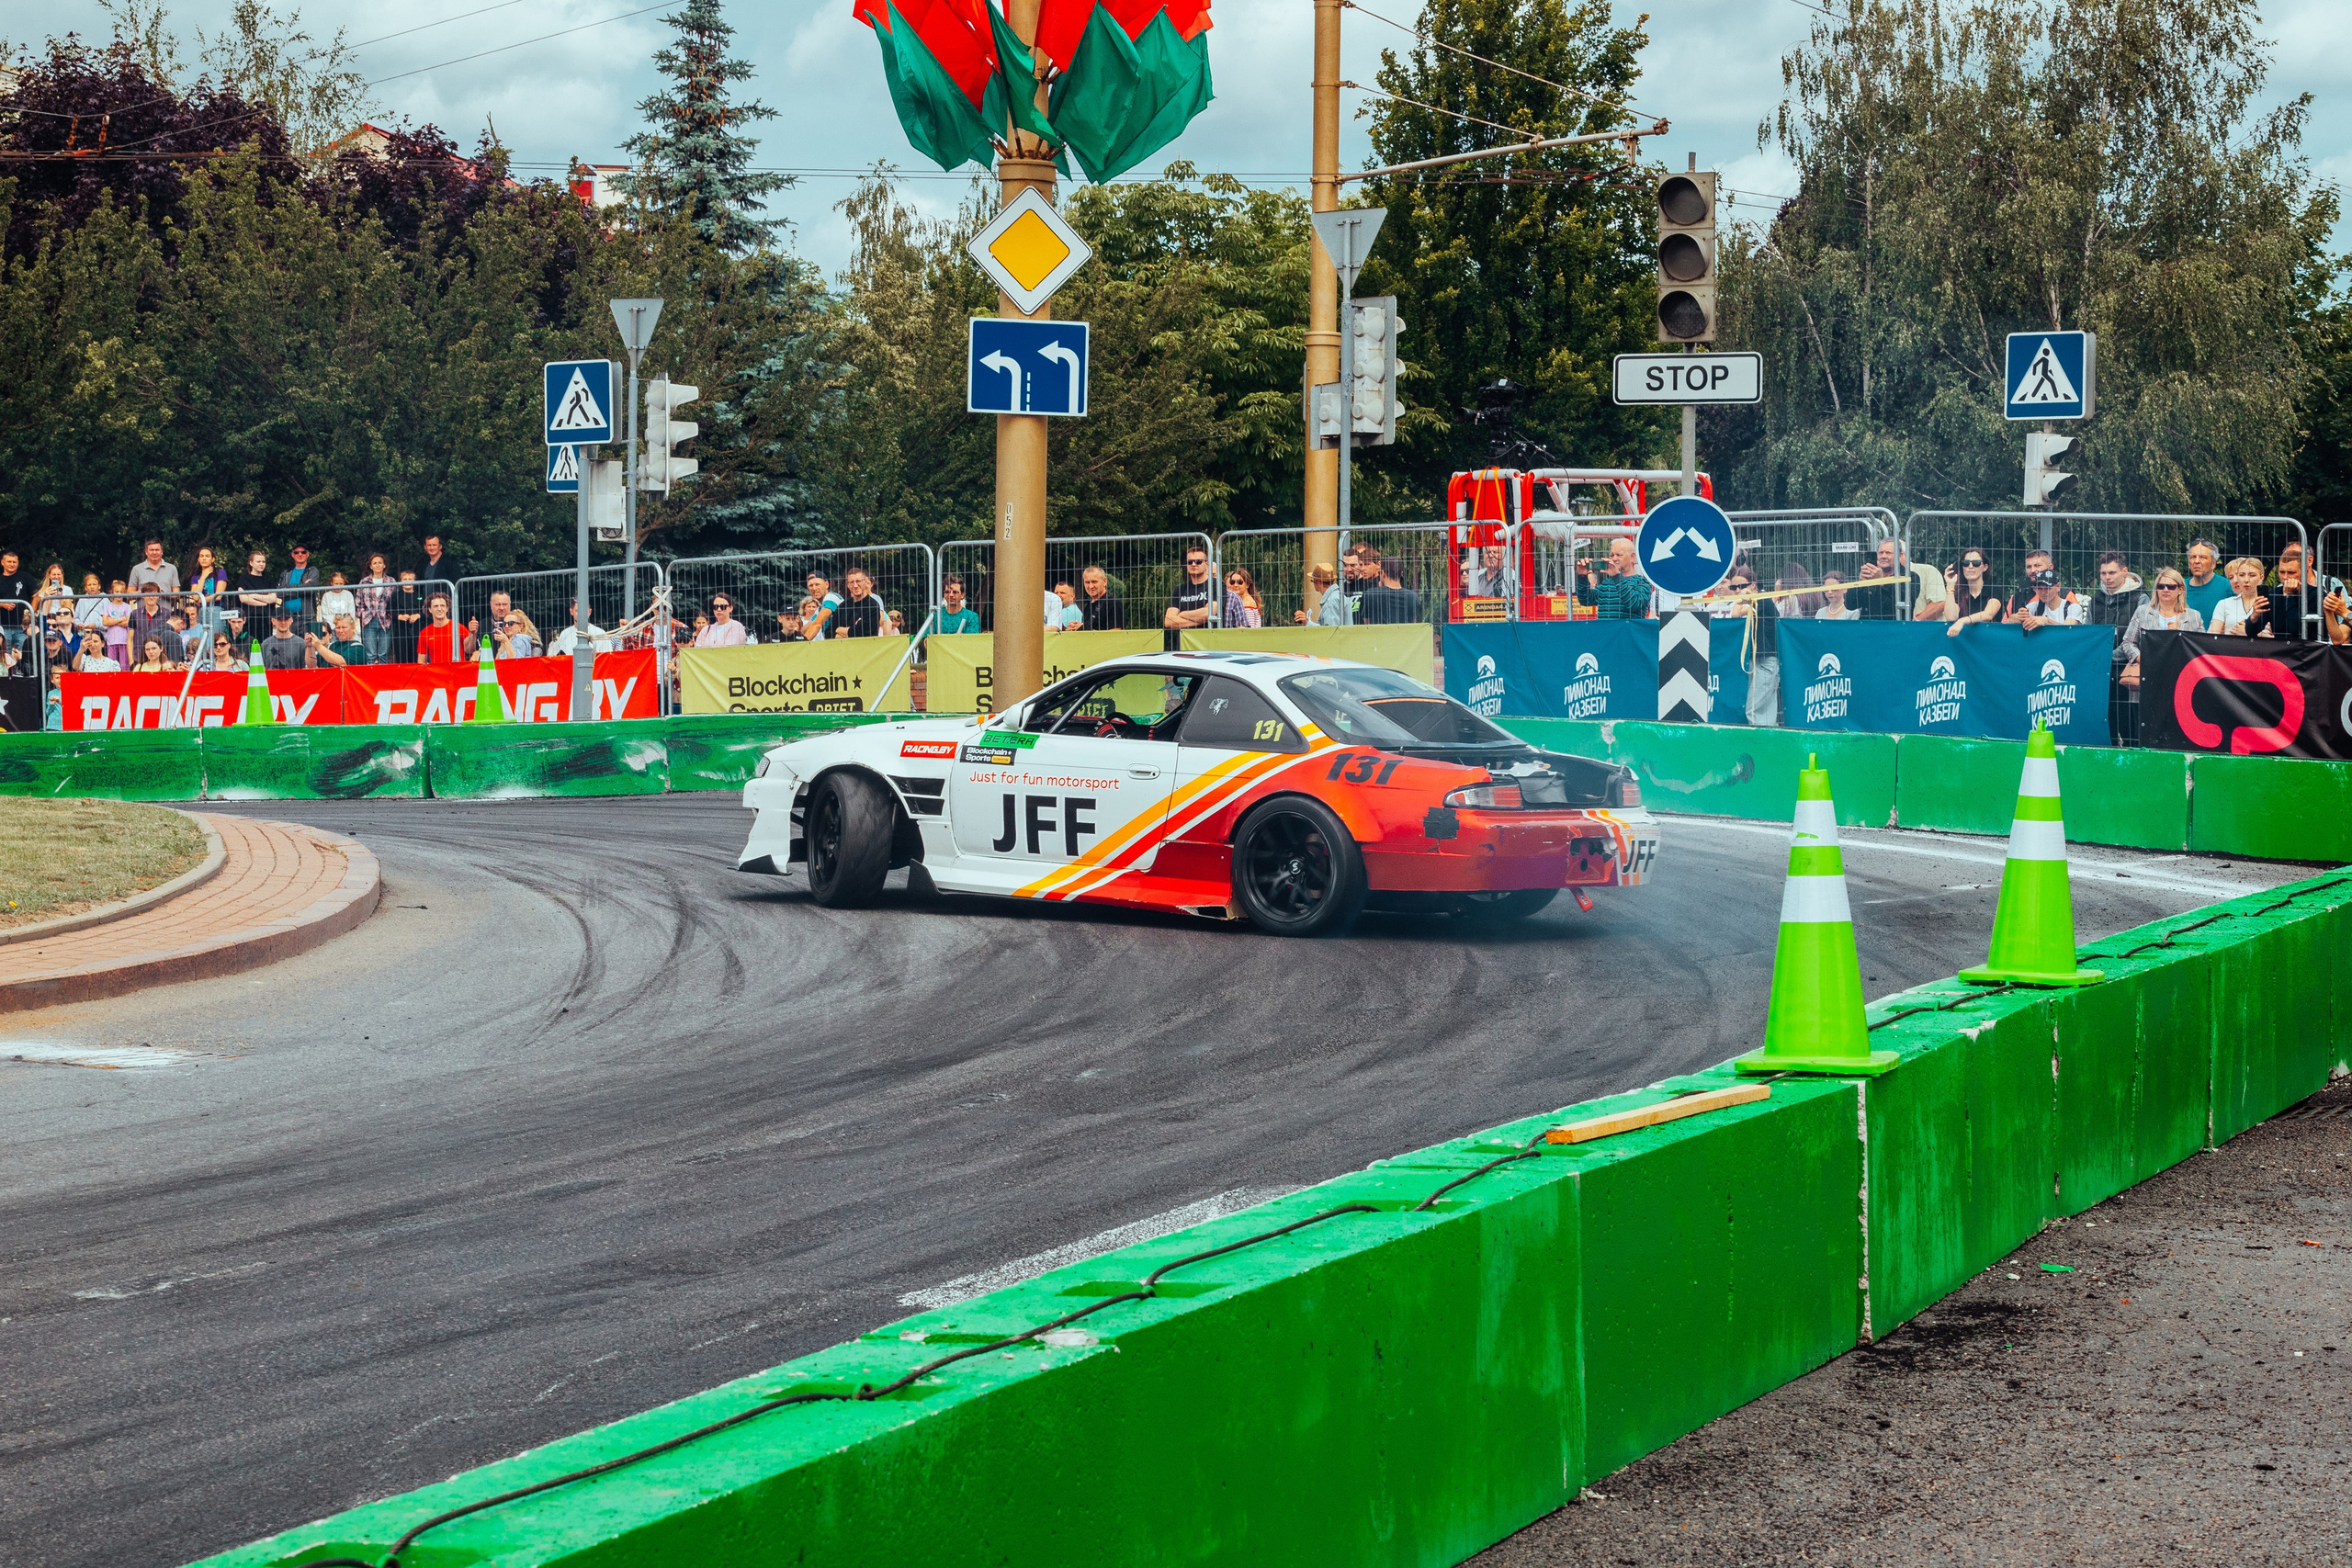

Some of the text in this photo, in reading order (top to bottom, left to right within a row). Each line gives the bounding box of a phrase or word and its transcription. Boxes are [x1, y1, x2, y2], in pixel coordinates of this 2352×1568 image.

[1645, 365, 1729, 391] STOP
[729, 671, 848, 698] Blockchain
[1468, 677, 1506, 705] ЛИМОНАД
[1563, 675, 1611, 705] ЛИМОНАД
[1804, 678, 1852, 706] ЛИМОНАД
[1916, 681, 1966, 710] ЛИМОНАД
[1568, 696, 1607, 719] КАЗБЕГИ
[1806, 699, 1848, 723] КАЗБЕГИ
[2027, 684, 2076, 715] ЛИМОНАД
[1918, 702, 1961, 728] КАЗБЕГИ
[1253, 719, 1284, 742] 131
[965, 754, 991, 762] Sports
[967, 747, 1008, 756] Blockchain
[969, 771, 1120, 792] Just for fun motorsport
[1325, 752, 1404, 785] 131
[992, 794, 1097, 856] JFF
[1622, 840, 1657, 874] JFF
